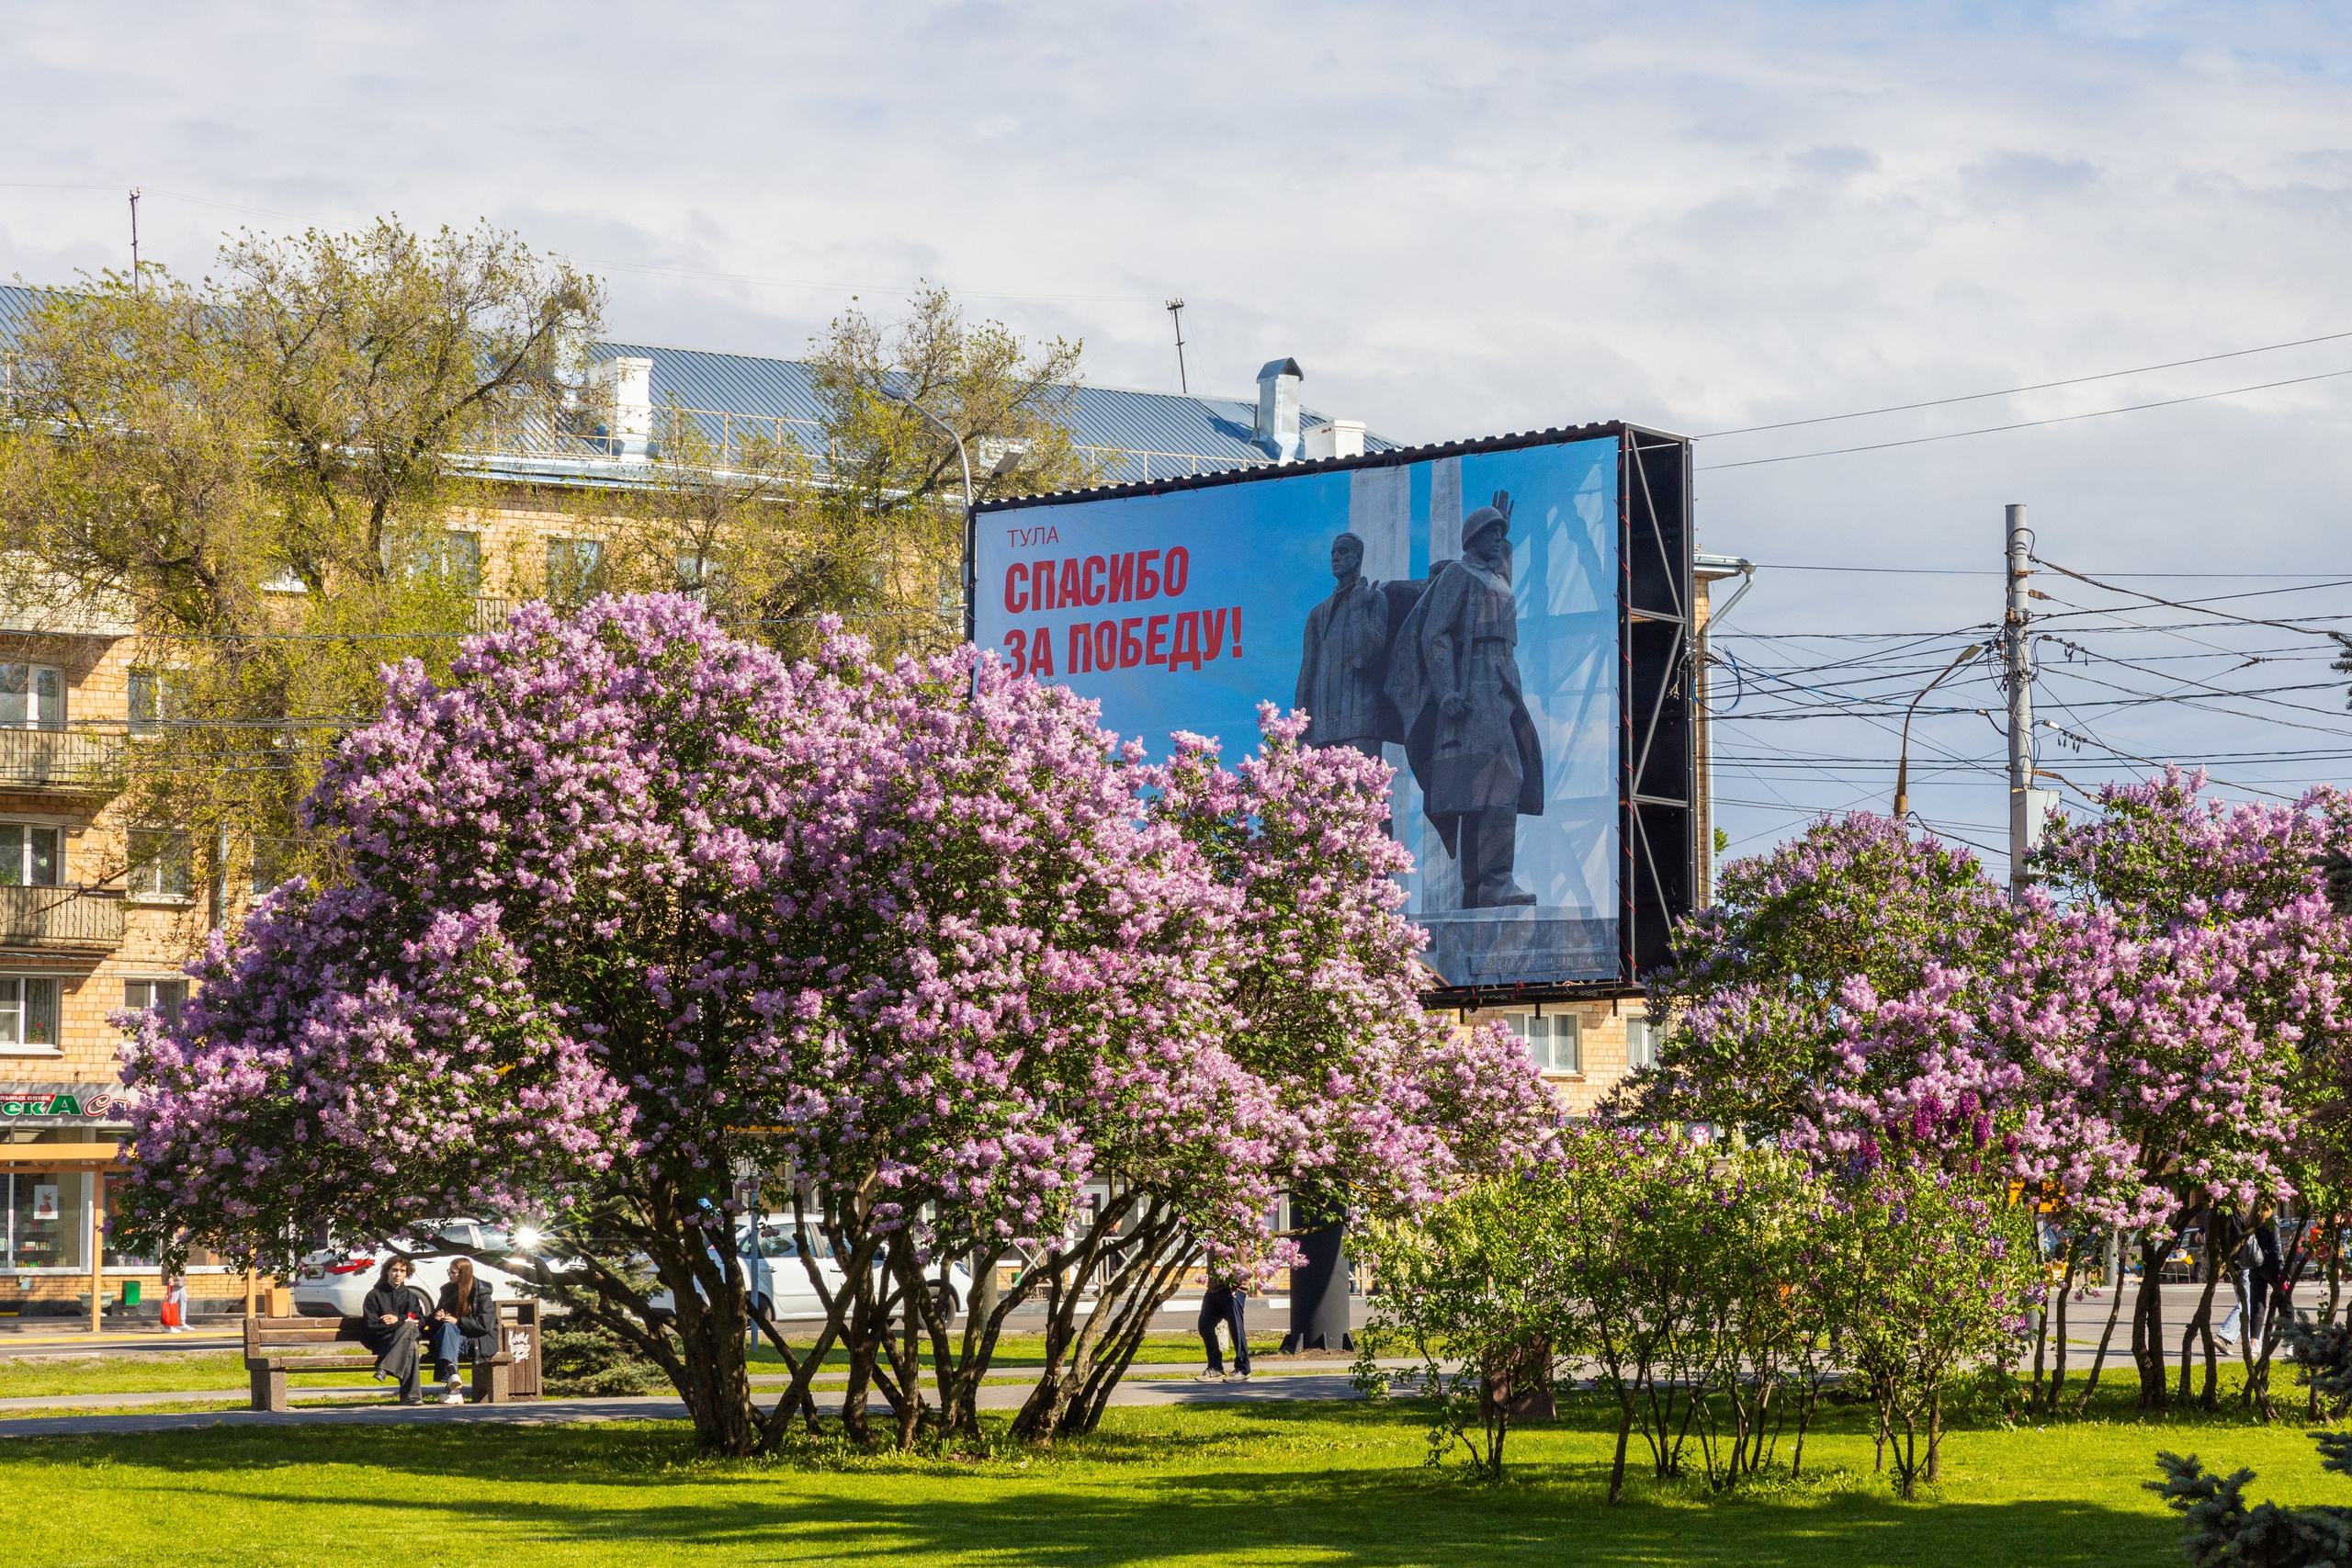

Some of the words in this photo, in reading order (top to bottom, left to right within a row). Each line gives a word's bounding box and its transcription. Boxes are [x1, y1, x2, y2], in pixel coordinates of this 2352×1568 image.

[1007, 526, 1059, 548] ТУЛА
[1004, 546, 1190, 614] СПАСИБО
[1002, 627, 1054, 680] ЗА
[1068, 606, 1243, 674] ПОБЕДУ!
[0, 1094, 83, 1116] екА
